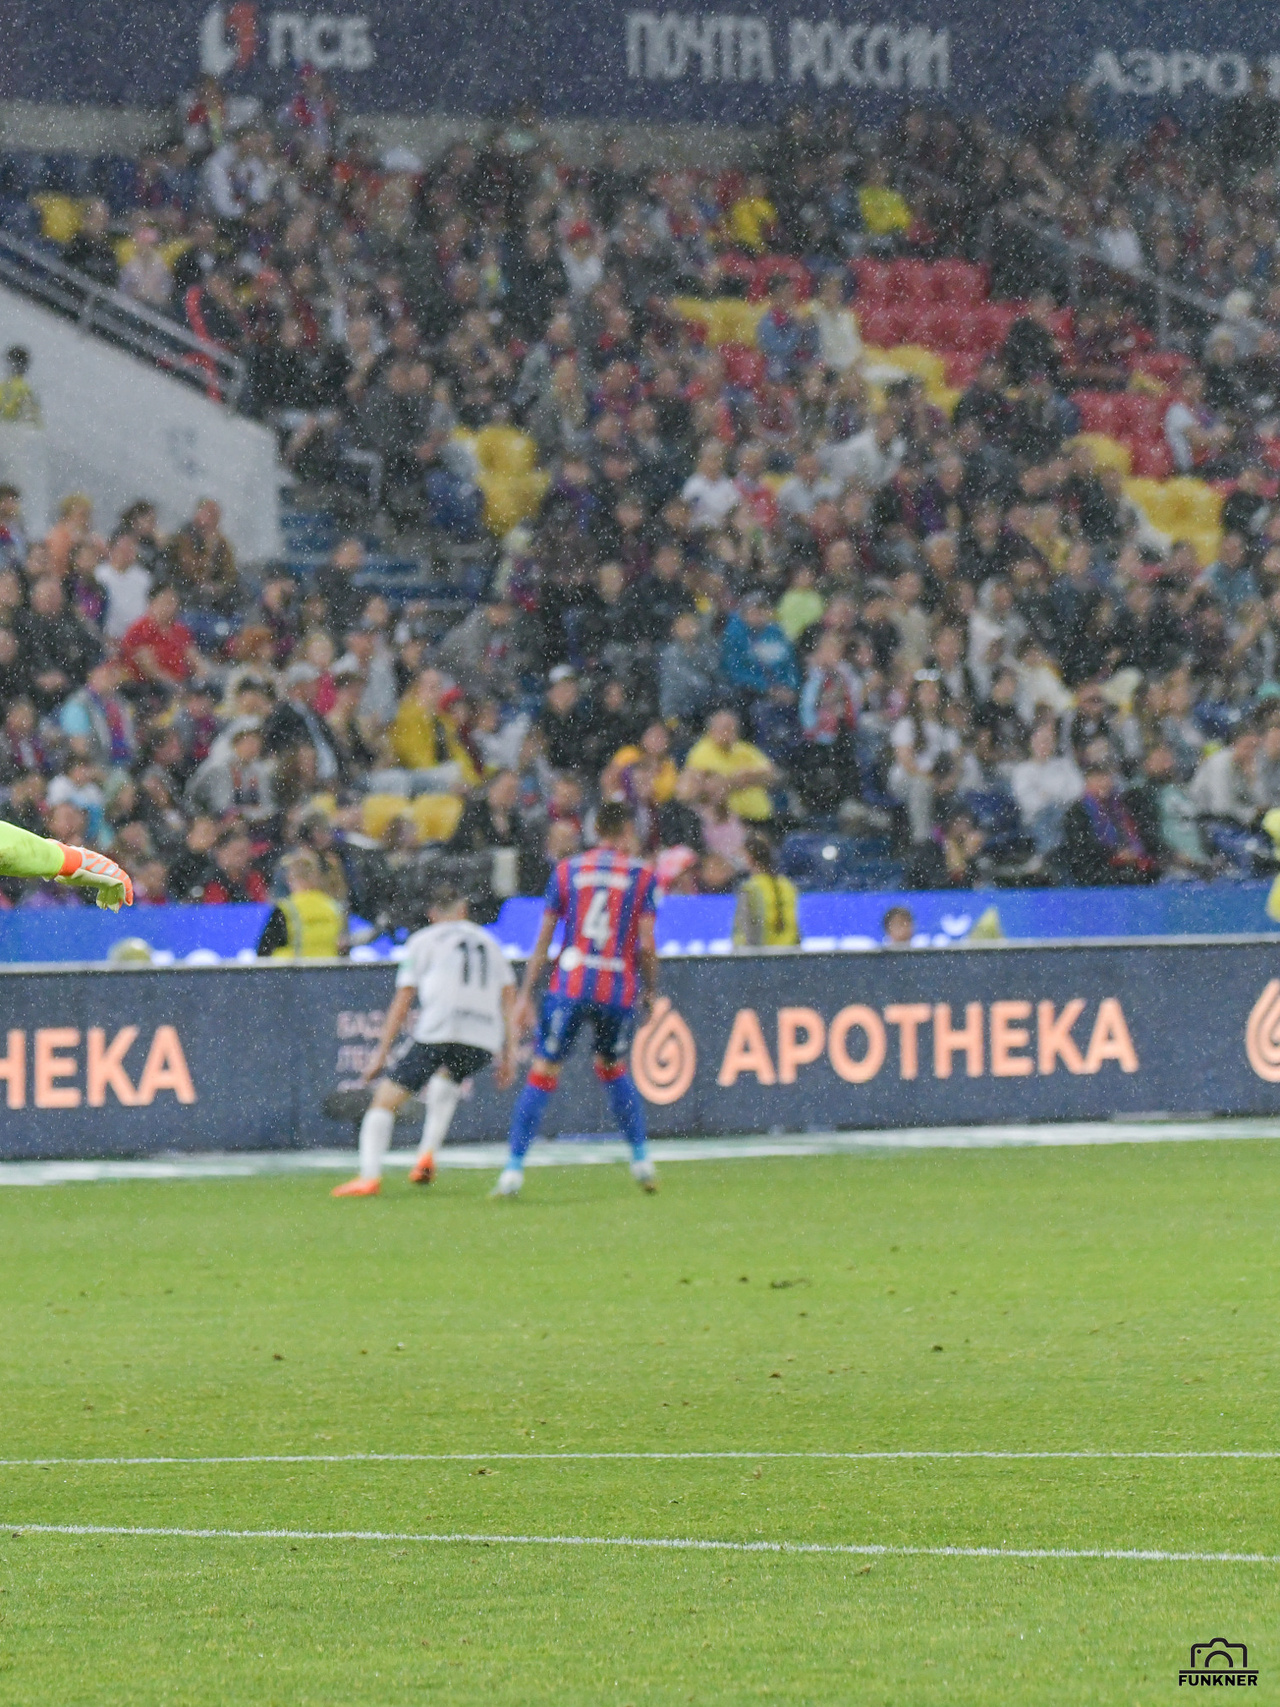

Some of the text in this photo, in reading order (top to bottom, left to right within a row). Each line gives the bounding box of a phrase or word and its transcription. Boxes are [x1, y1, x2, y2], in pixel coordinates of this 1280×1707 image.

[269, 12, 373, 71] ПСБ
[624, 14, 952, 89] ПОЧТА РОССИИ
[1082, 50, 1280, 98] АЭРО
[581, 889, 614, 950] 4
[458, 940, 488, 990] 11
[718, 997, 1139, 1088] APOTHEKA
